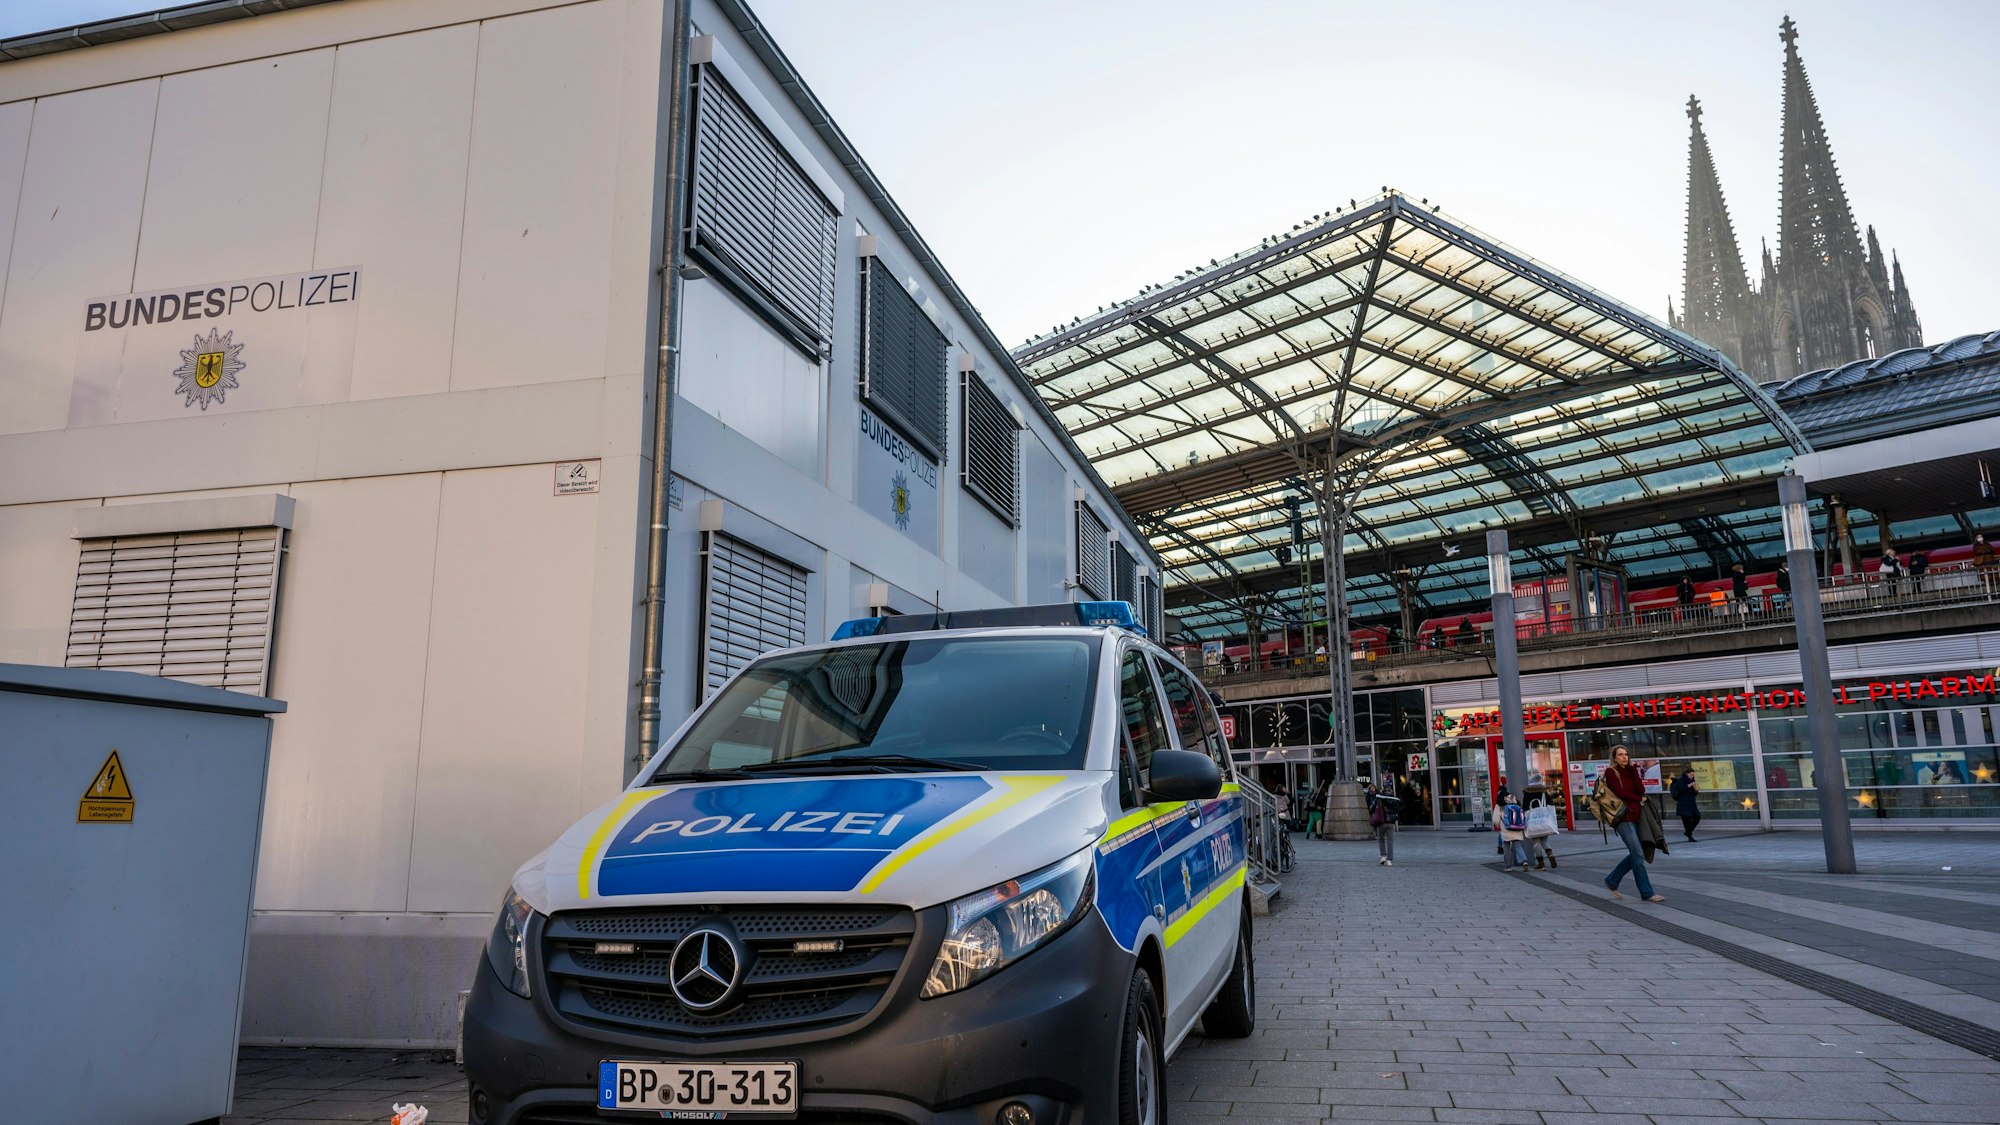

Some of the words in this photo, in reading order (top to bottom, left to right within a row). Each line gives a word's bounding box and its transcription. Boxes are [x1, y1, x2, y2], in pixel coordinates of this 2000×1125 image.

[84, 270, 359, 332] BUNDESPOLIZEI
[861, 409, 937, 490] BUNDESPOLIZEI
[1459, 705, 1580, 728] APOHEKE
[1619, 685, 1856, 719] INTERNATIONL
[1869, 674, 1996, 702] PHARM
[630, 811, 905, 844] POLIZEI
[1210, 832, 1233, 876] POLIZEI
[605, 1089, 612, 1100] D
[619, 1069, 657, 1103] BP
[677, 1070, 792, 1105] 30-313
